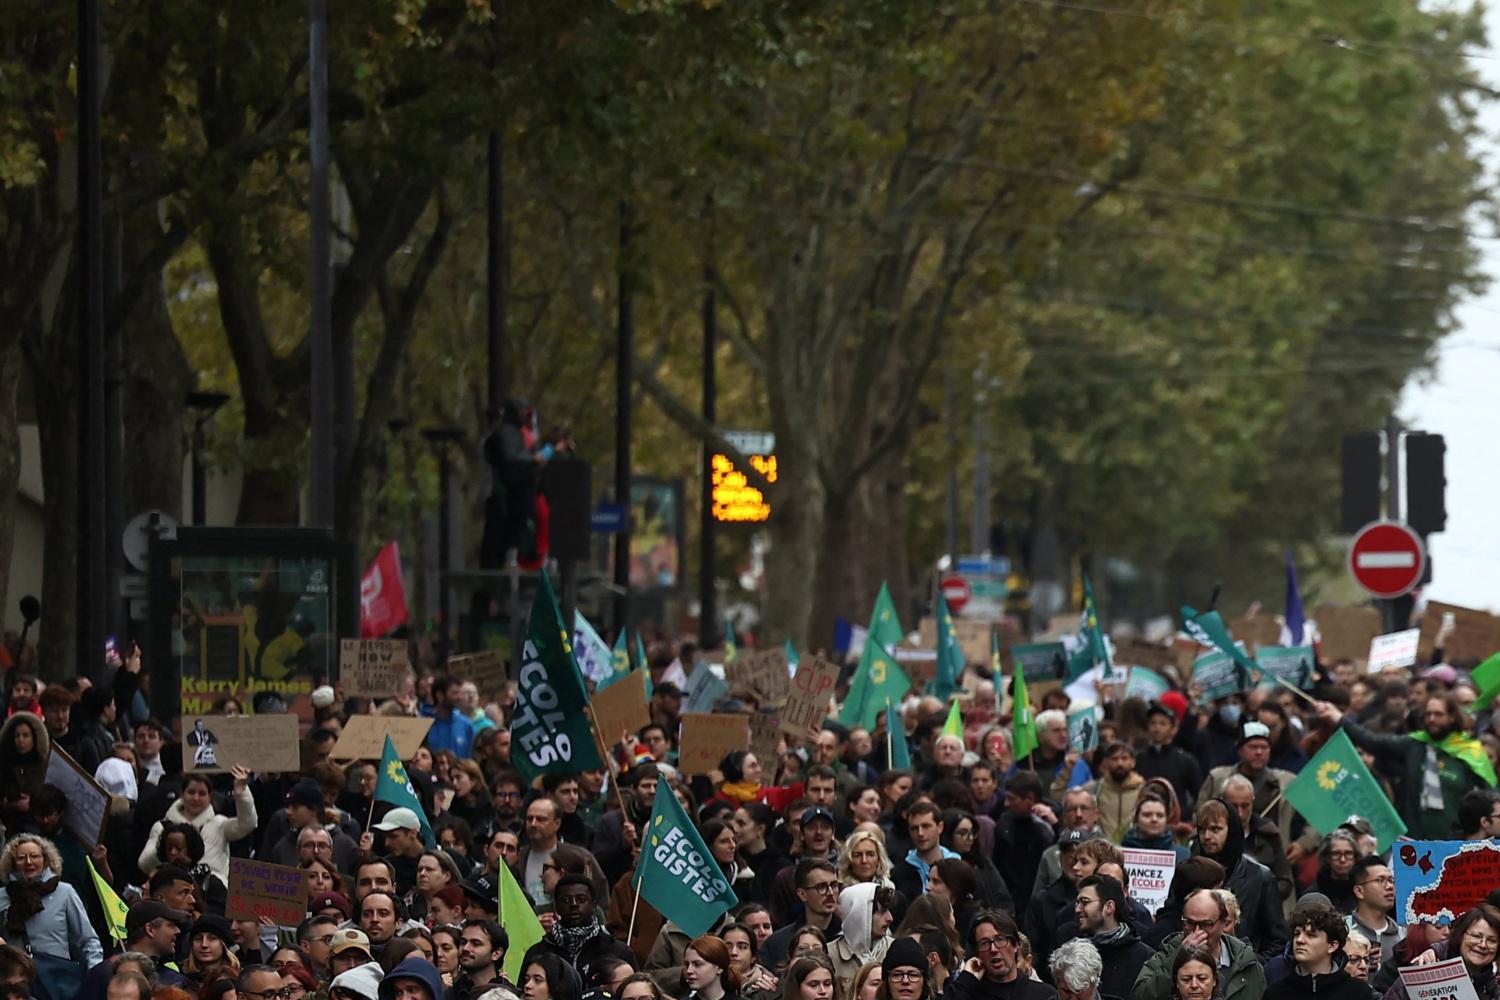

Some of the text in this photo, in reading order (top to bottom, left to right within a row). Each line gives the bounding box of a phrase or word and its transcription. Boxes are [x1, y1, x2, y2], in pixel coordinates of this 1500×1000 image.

[182, 677, 312, 696] Kerry James
[654, 844, 719, 903] GISTES
[664, 826, 727, 895] ECOLO
